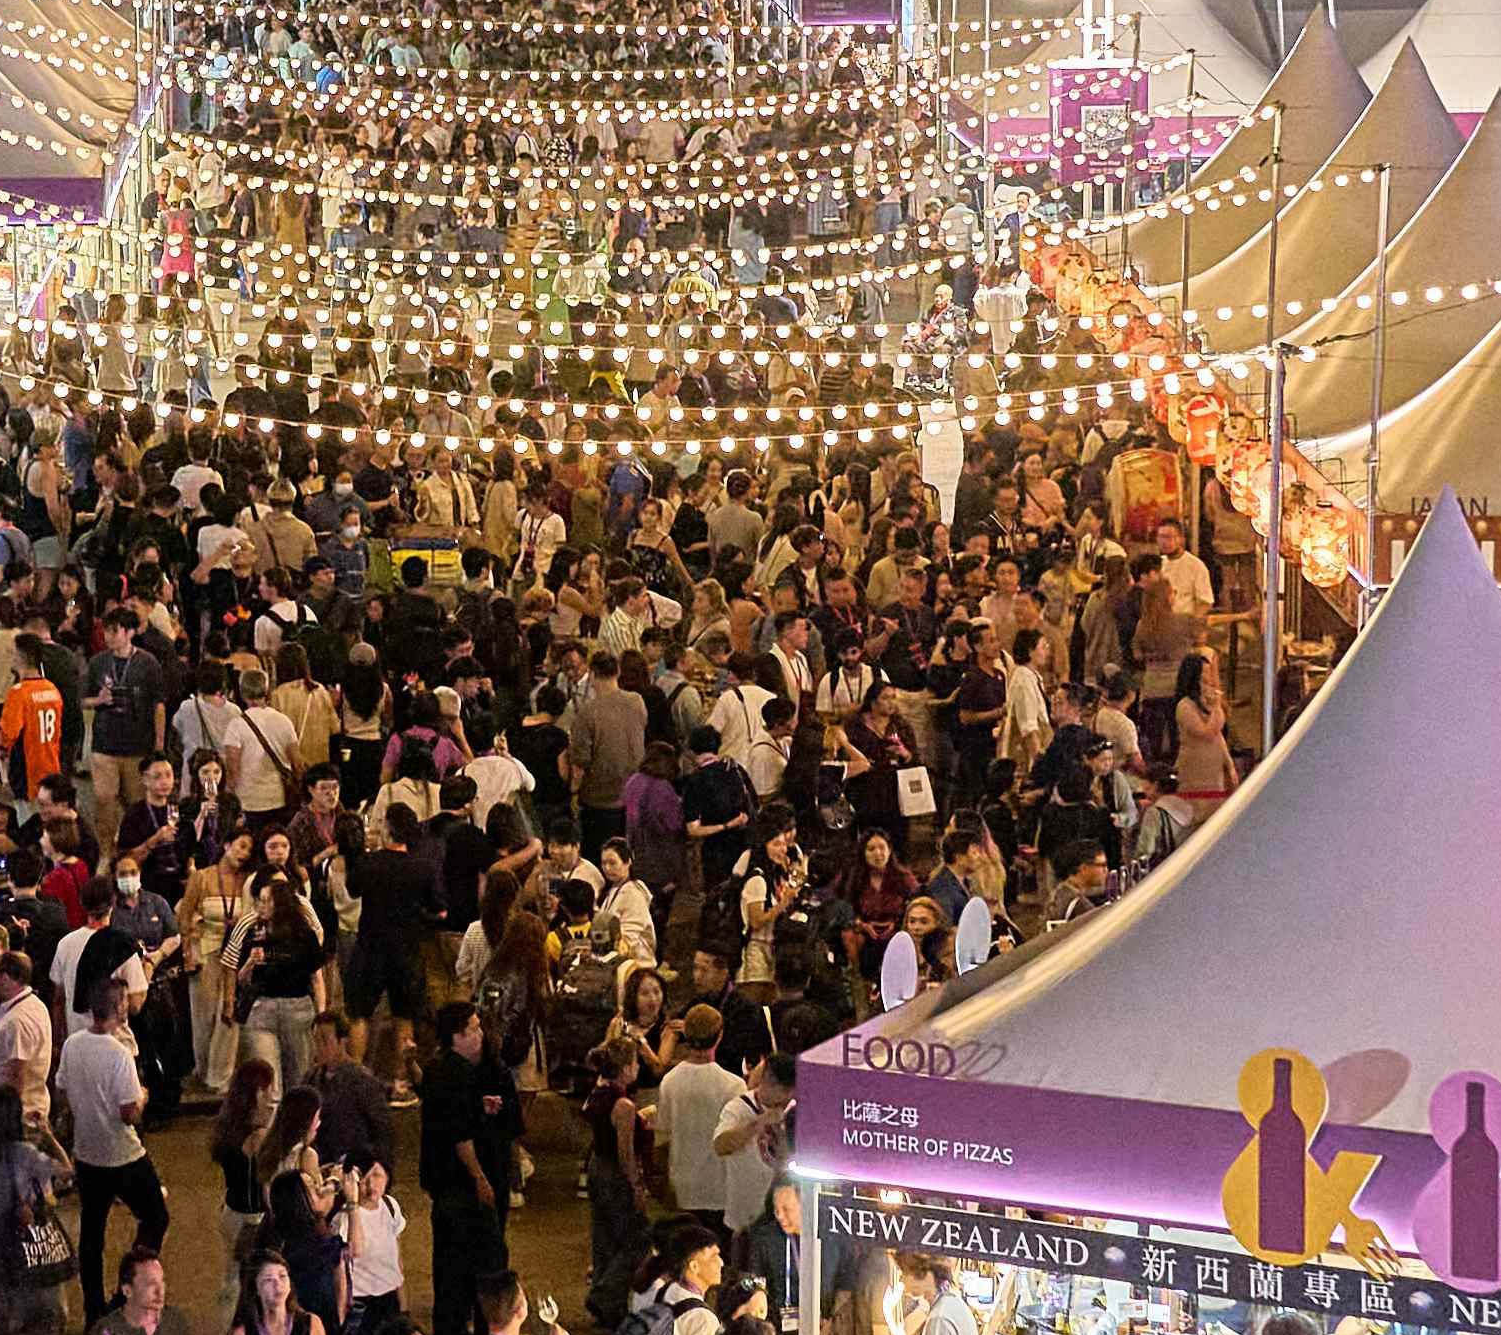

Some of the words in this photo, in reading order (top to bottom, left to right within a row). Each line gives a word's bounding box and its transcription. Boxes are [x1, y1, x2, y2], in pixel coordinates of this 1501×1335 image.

[37, 708, 56, 744] 18
[842, 1033, 956, 1077] FOOD
[843, 1099, 920, 1128] 比薩之母
[842, 1128, 919, 1155] MOTHER
[924, 1138, 948, 1157] OF
[953, 1142, 1014, 1166] PIZZAS
[829, 1207, 910, 1243] NEW
[920, 1218, 1090, 1266] ZEALAND
[1140, 1245, 1397, 1316] 新西蘭專區
